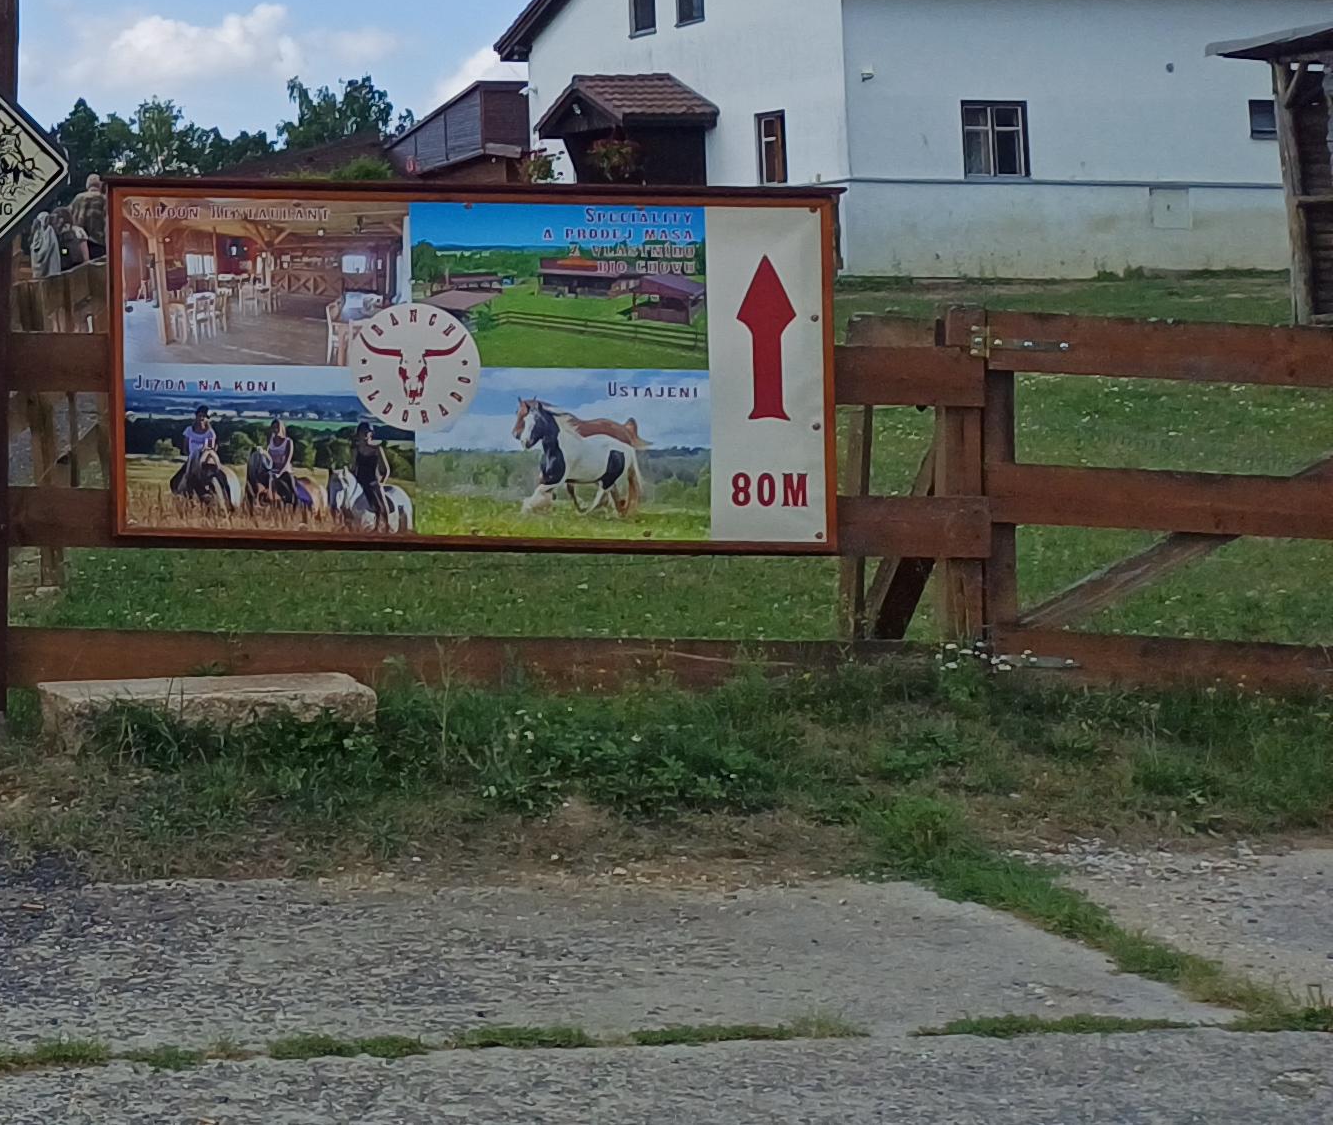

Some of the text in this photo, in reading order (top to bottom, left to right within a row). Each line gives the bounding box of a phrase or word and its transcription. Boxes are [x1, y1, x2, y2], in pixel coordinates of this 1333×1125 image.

[644, 228, 694, 241] MASA
[371, 308, 456, 337] RANCH
[198, 380, 222, 391] NA
